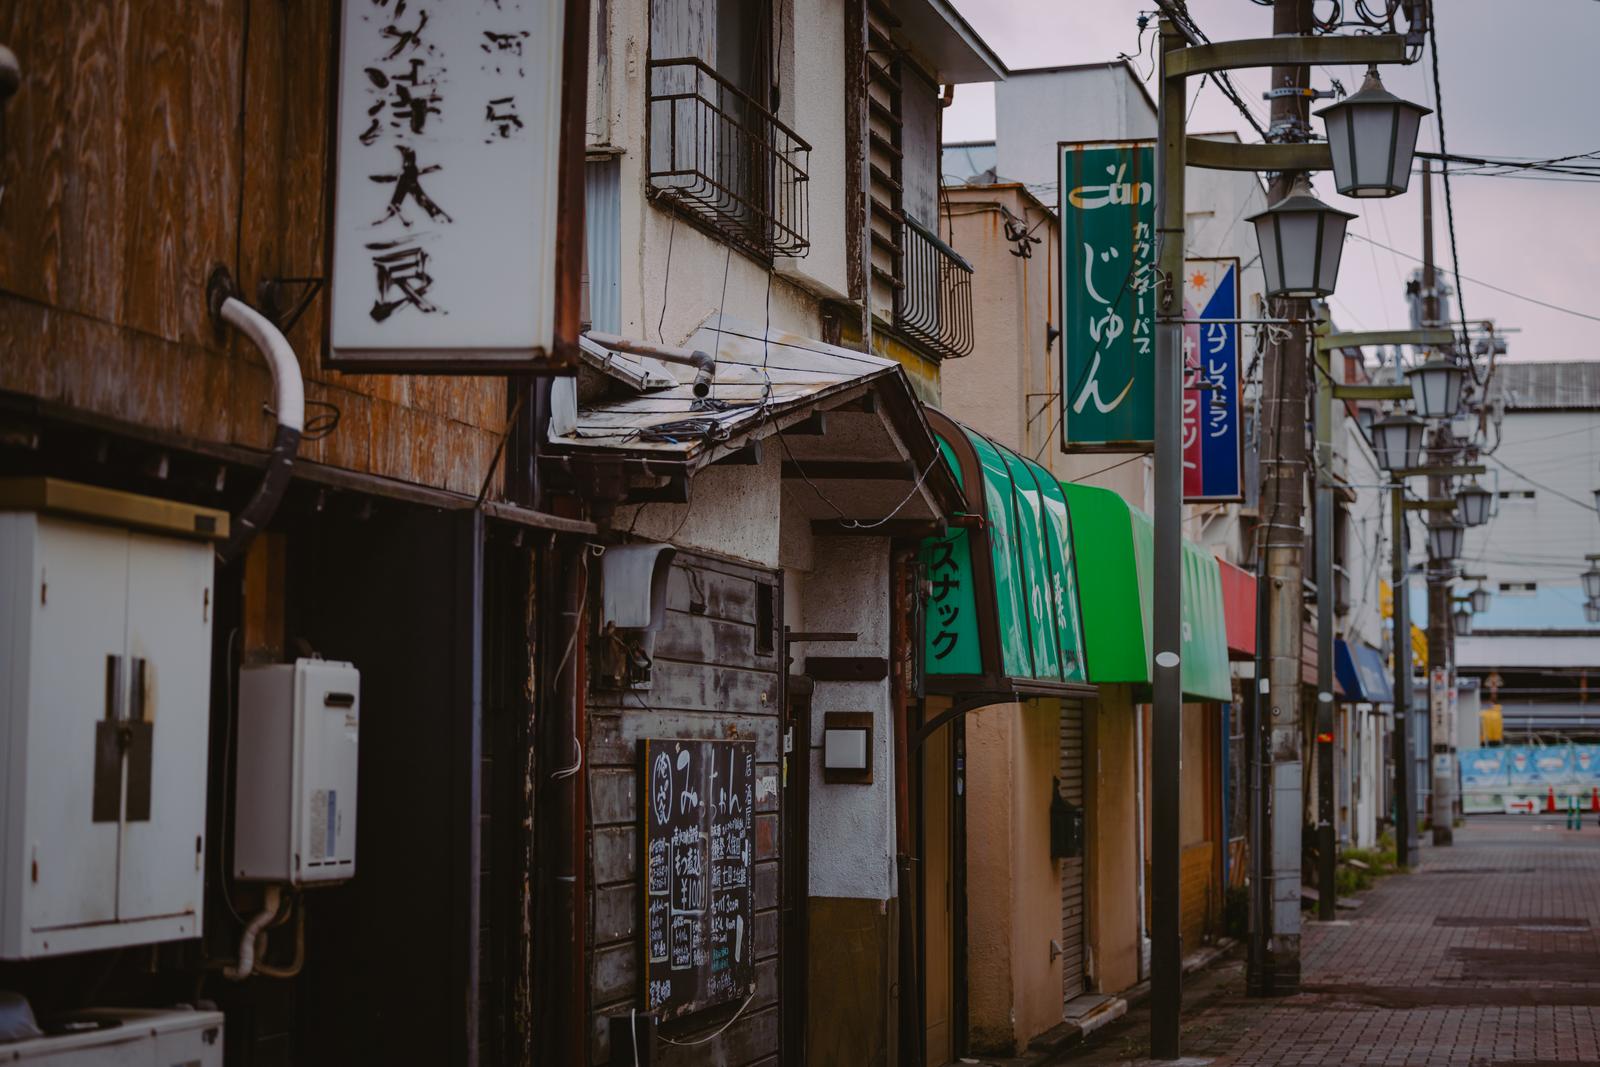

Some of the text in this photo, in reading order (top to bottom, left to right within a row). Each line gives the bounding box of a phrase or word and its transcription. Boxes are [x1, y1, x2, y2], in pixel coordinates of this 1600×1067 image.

[1073, 242, 1135, 415] じゅん
[931, 541, 960, 661] スナック
